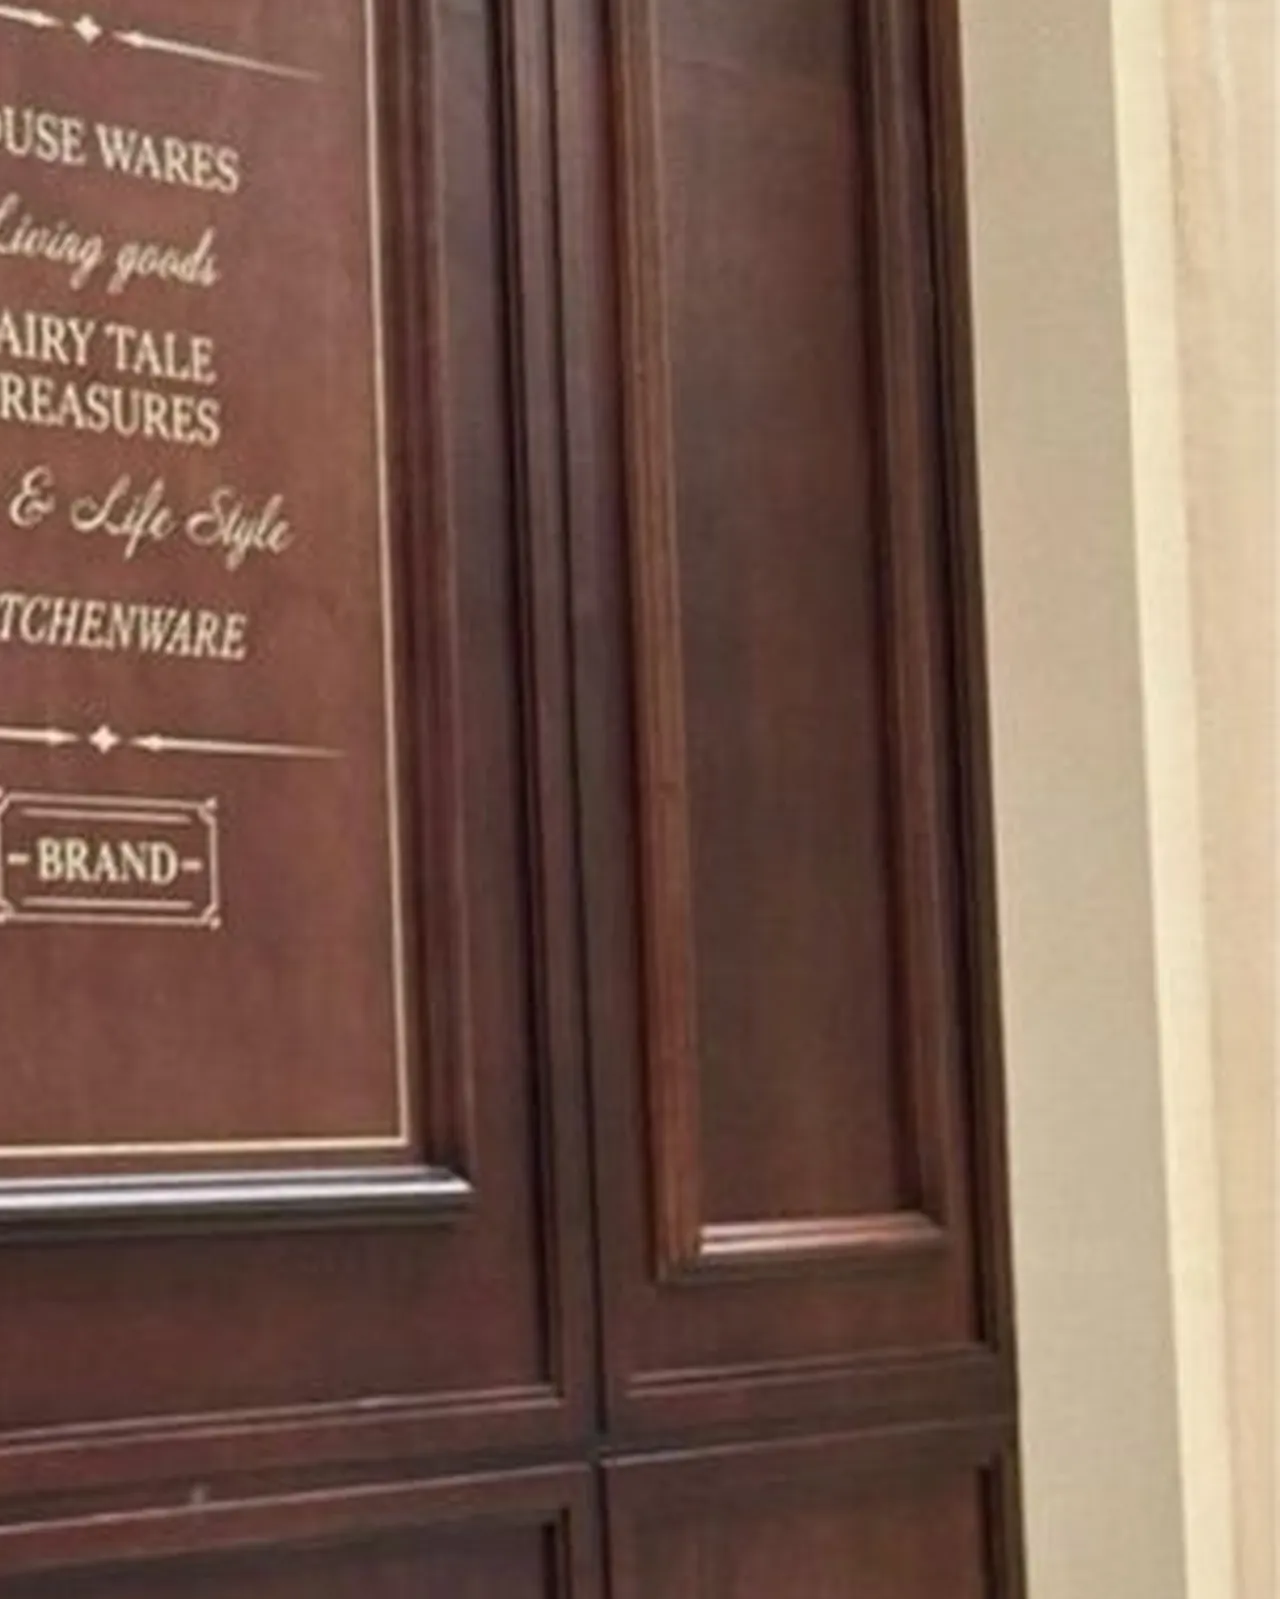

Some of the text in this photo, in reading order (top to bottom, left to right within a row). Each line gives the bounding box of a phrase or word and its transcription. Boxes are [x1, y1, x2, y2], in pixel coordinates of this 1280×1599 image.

[95, 122, 241, 196] WARES
[106, 226, 222, 296] goods
[104, 320, 218, 385] TALE
[7, 464, 57, 529] &
[69, 473, 174, 561] Life
[185, 485, 297, 572] Style
